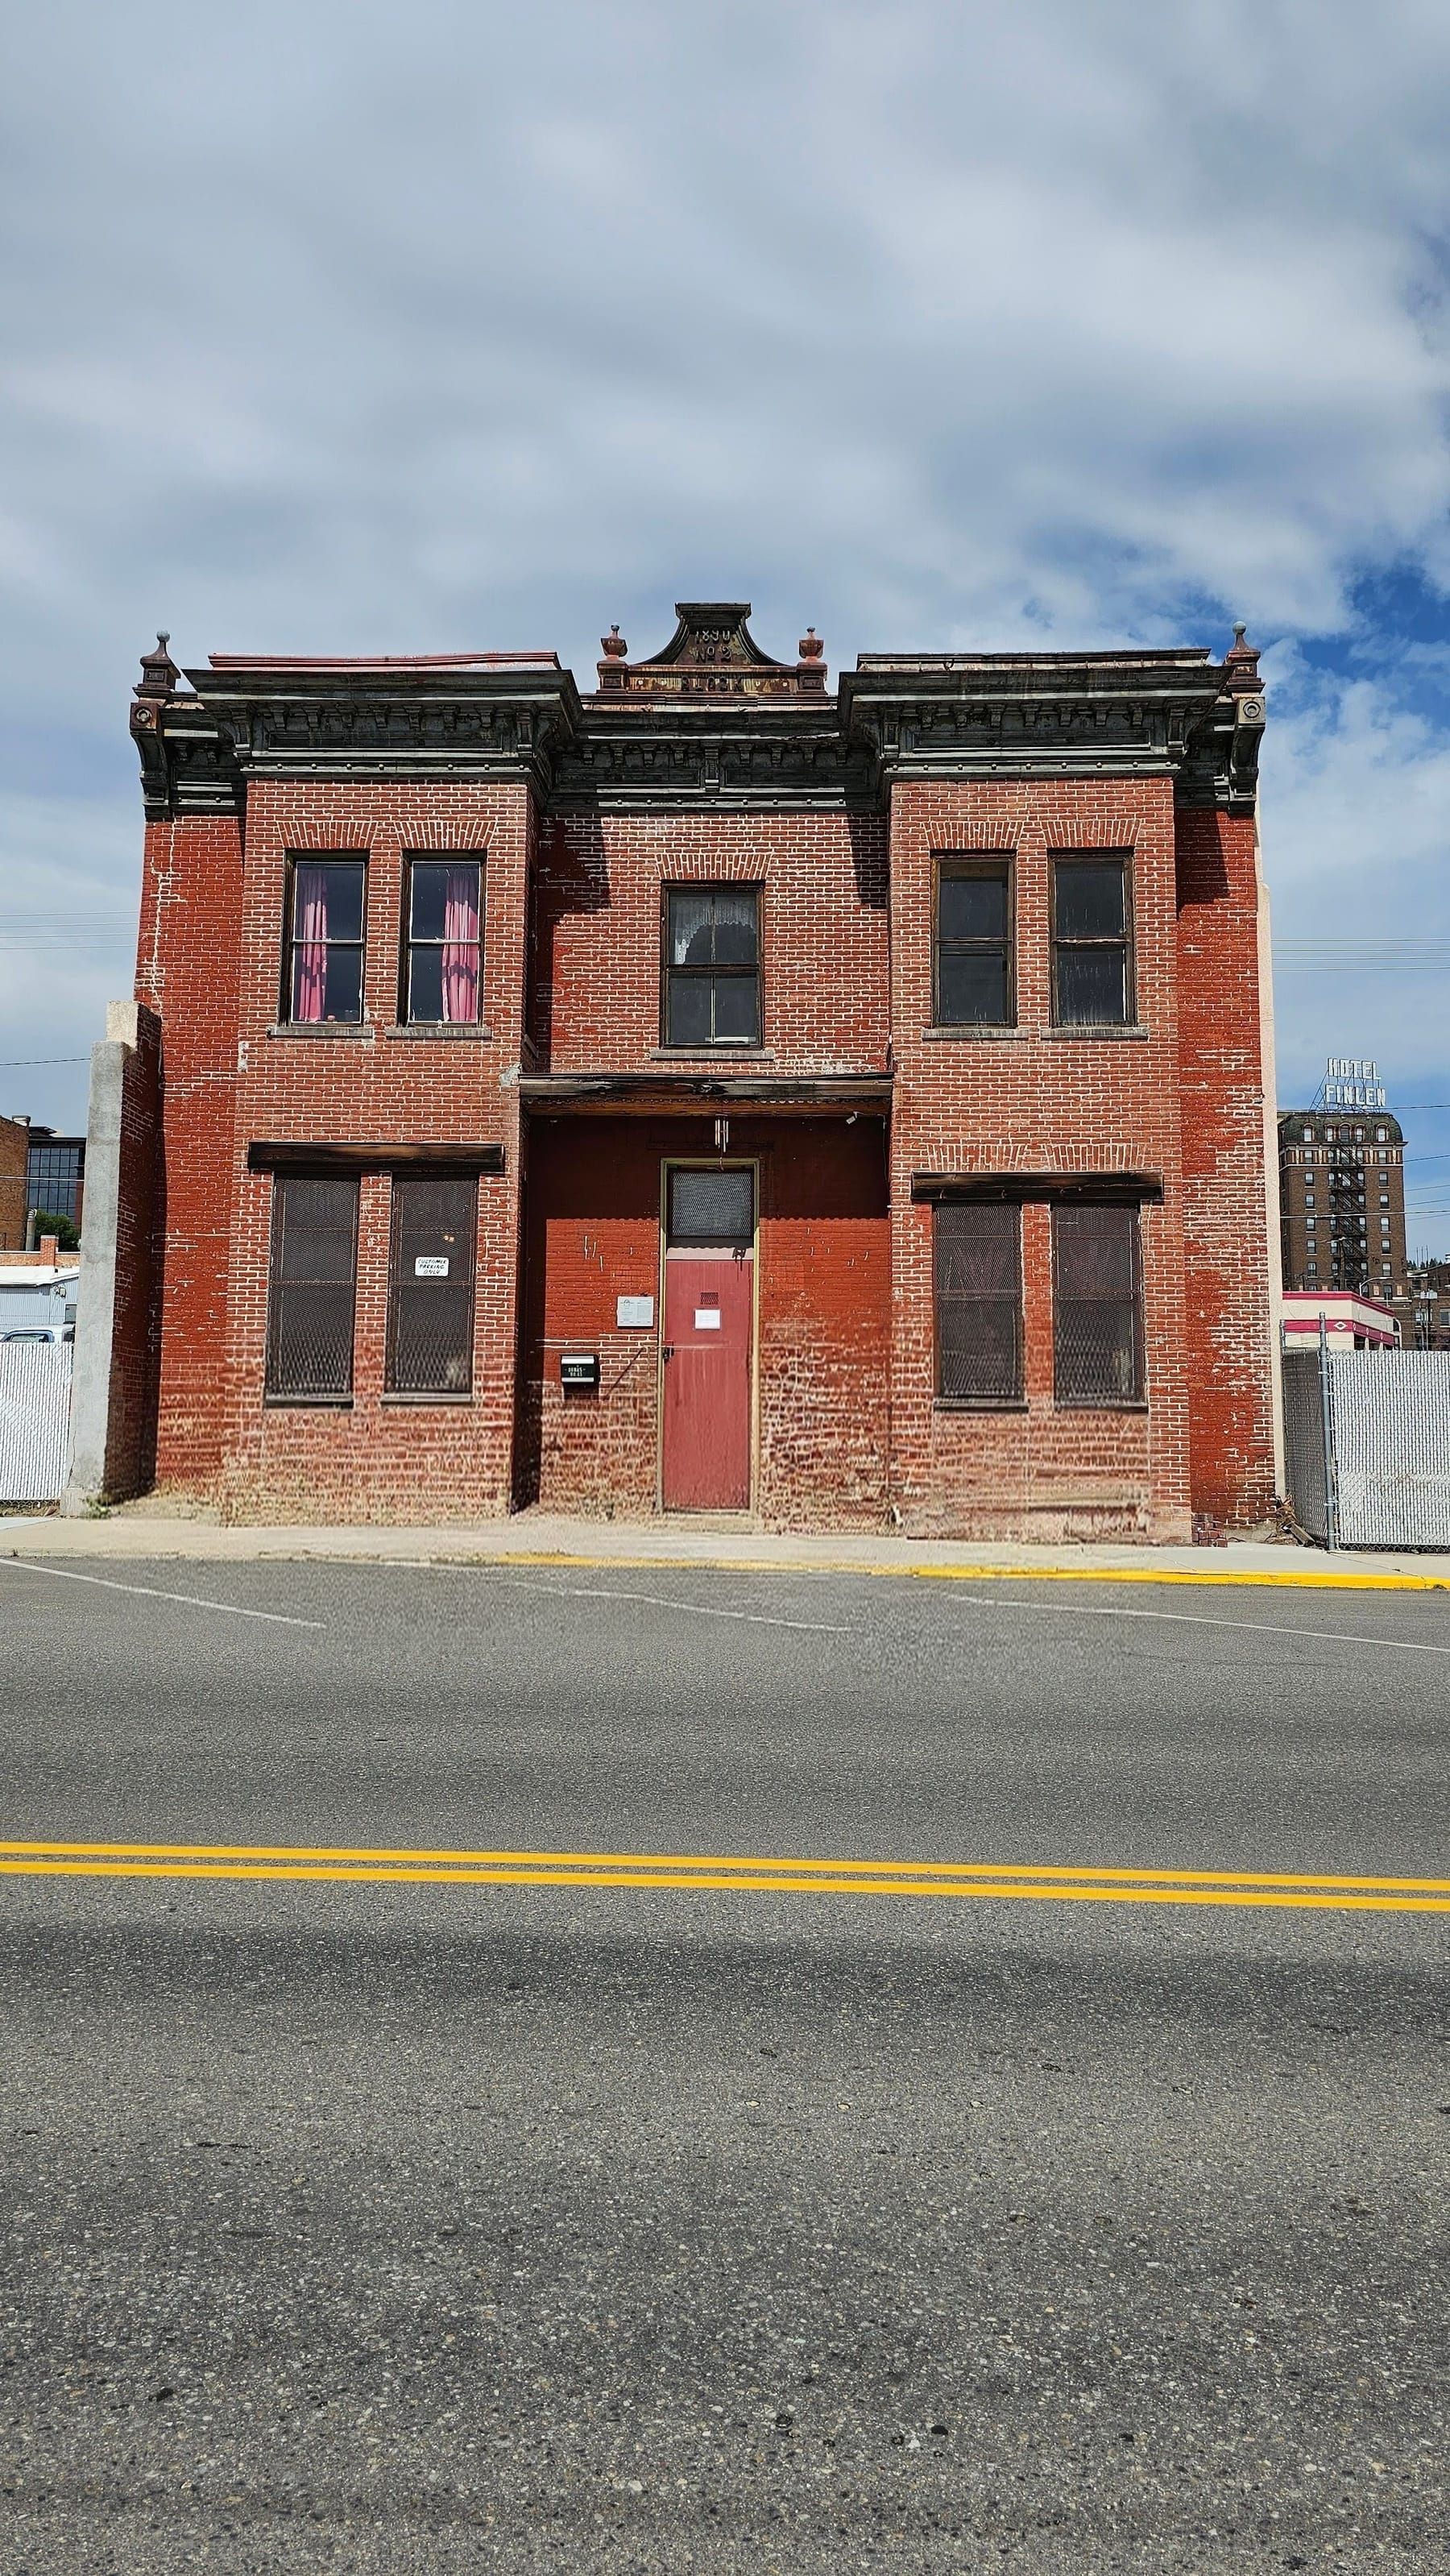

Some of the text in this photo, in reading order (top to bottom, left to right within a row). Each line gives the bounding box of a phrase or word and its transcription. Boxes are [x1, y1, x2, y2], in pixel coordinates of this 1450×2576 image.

[695, 630, 731, 643] 1890
[1328, 1057, 1382, 1081] HOTEL
[1325, 1084, 1386, 1107] FINLEN
